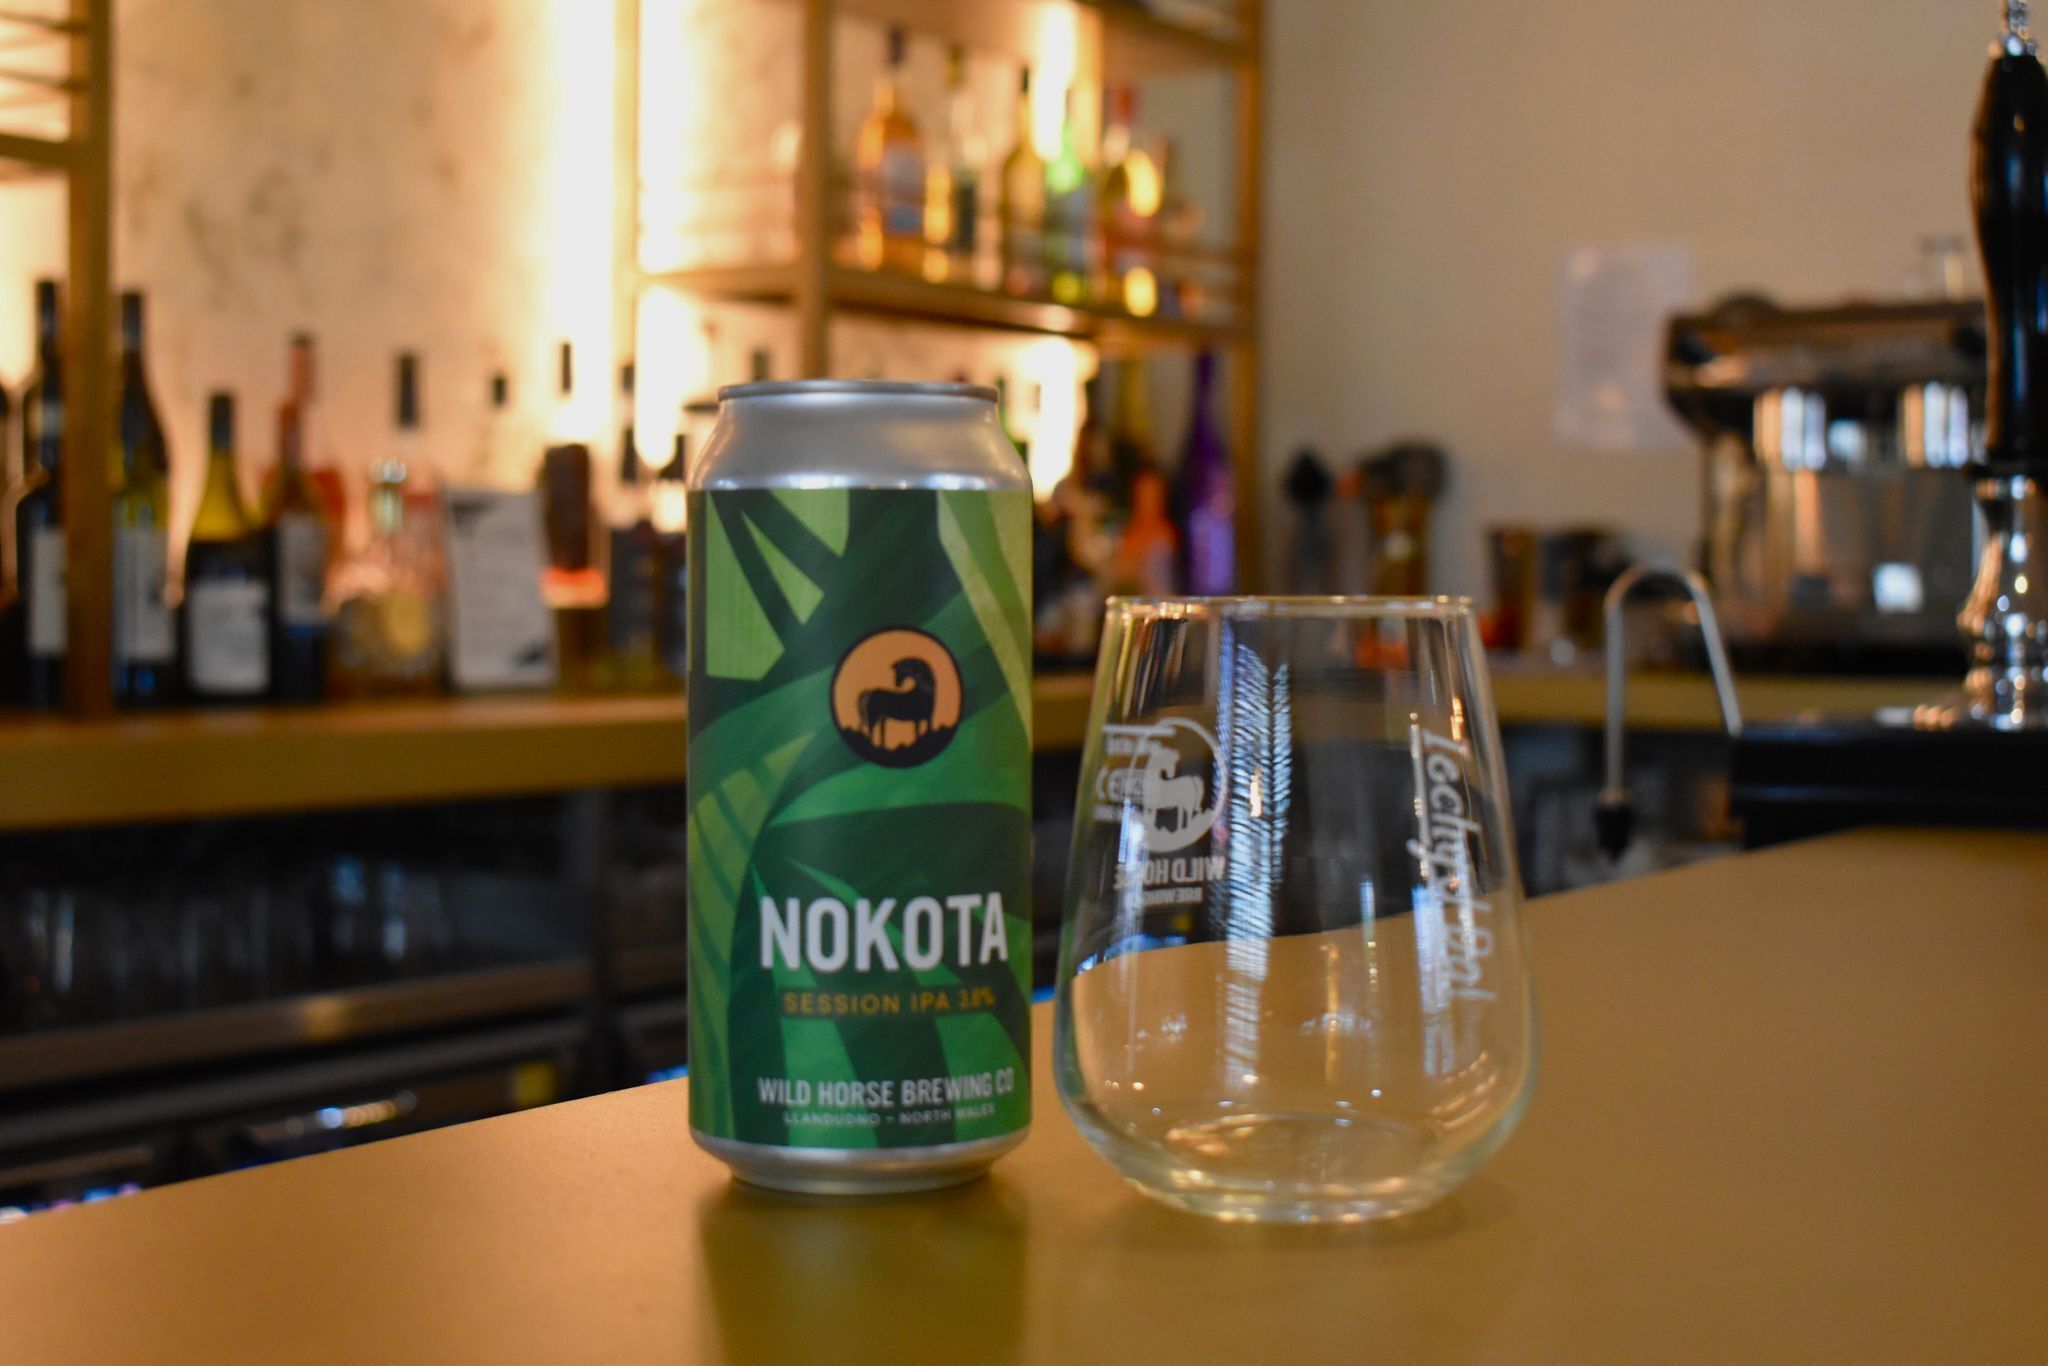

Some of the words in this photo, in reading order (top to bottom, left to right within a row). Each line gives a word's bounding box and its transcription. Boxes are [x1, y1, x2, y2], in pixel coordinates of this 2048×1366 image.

[760, 891, 1009, 973] NOKOTA
[783, 992, 900, 1015] SESSION
[910, 991, 951, 1013] IPA
[757, 1077, 812, 1106] WILD
[816, 1079, 895, 1109] HORSE
[901, 1071, 993, 1107] BREWING
[995, 1066, 1015, 1096] CO
[783, 1112, 881, 1127] LLANDUDNO
[899, 1109, 951, 1125] NORTH
